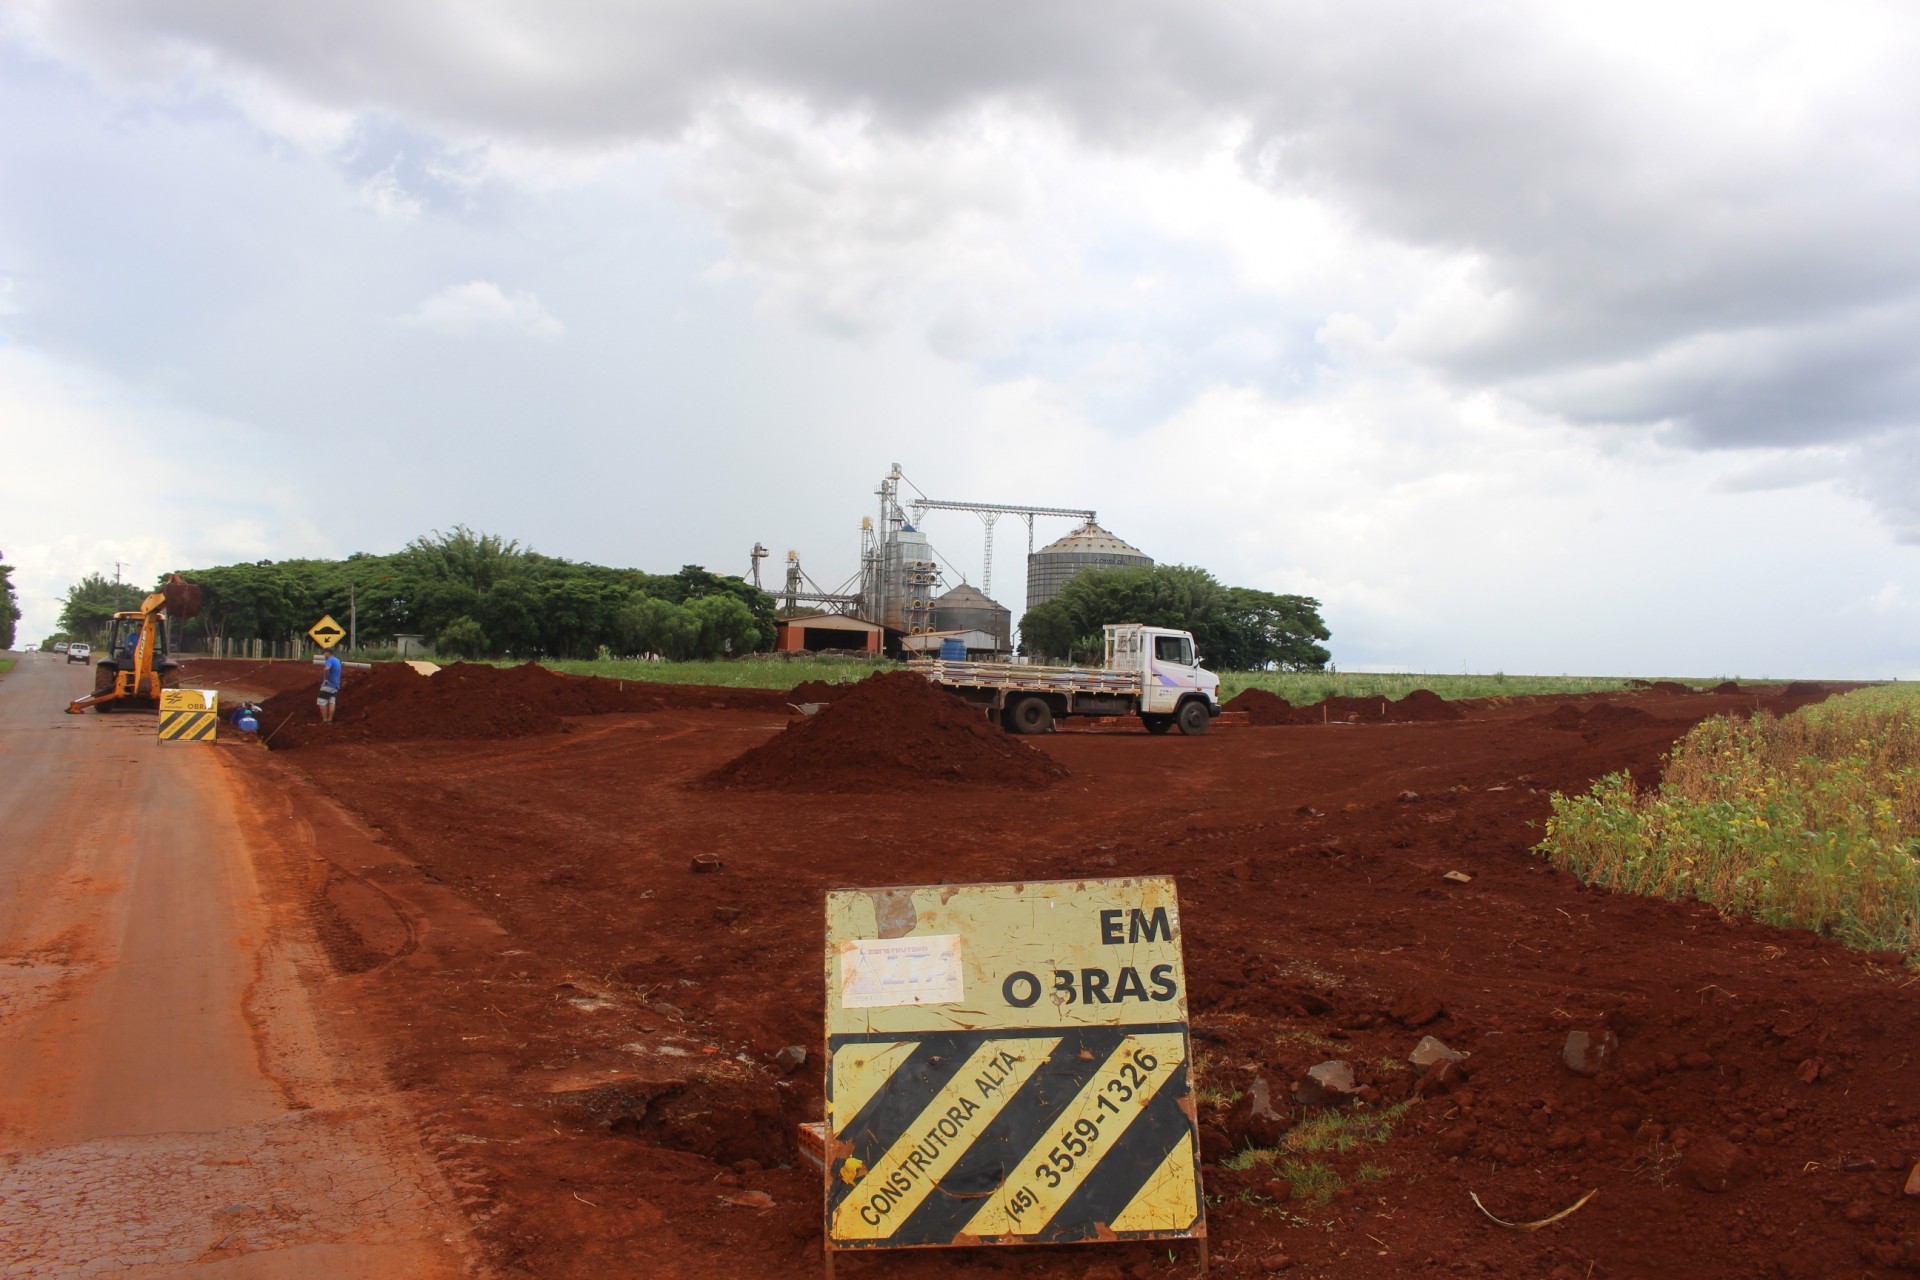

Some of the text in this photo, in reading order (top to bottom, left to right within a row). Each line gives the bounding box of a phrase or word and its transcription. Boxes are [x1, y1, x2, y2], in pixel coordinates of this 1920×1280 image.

[1100, 907, 1171, 945] EM
[1002, 964, 1177, 1008] OBRAS
[860, 1051, 1018, 1226] CONSTRUTORA ALTA
[1004, 1049, 1158, 1223] (45) 3559-1326
